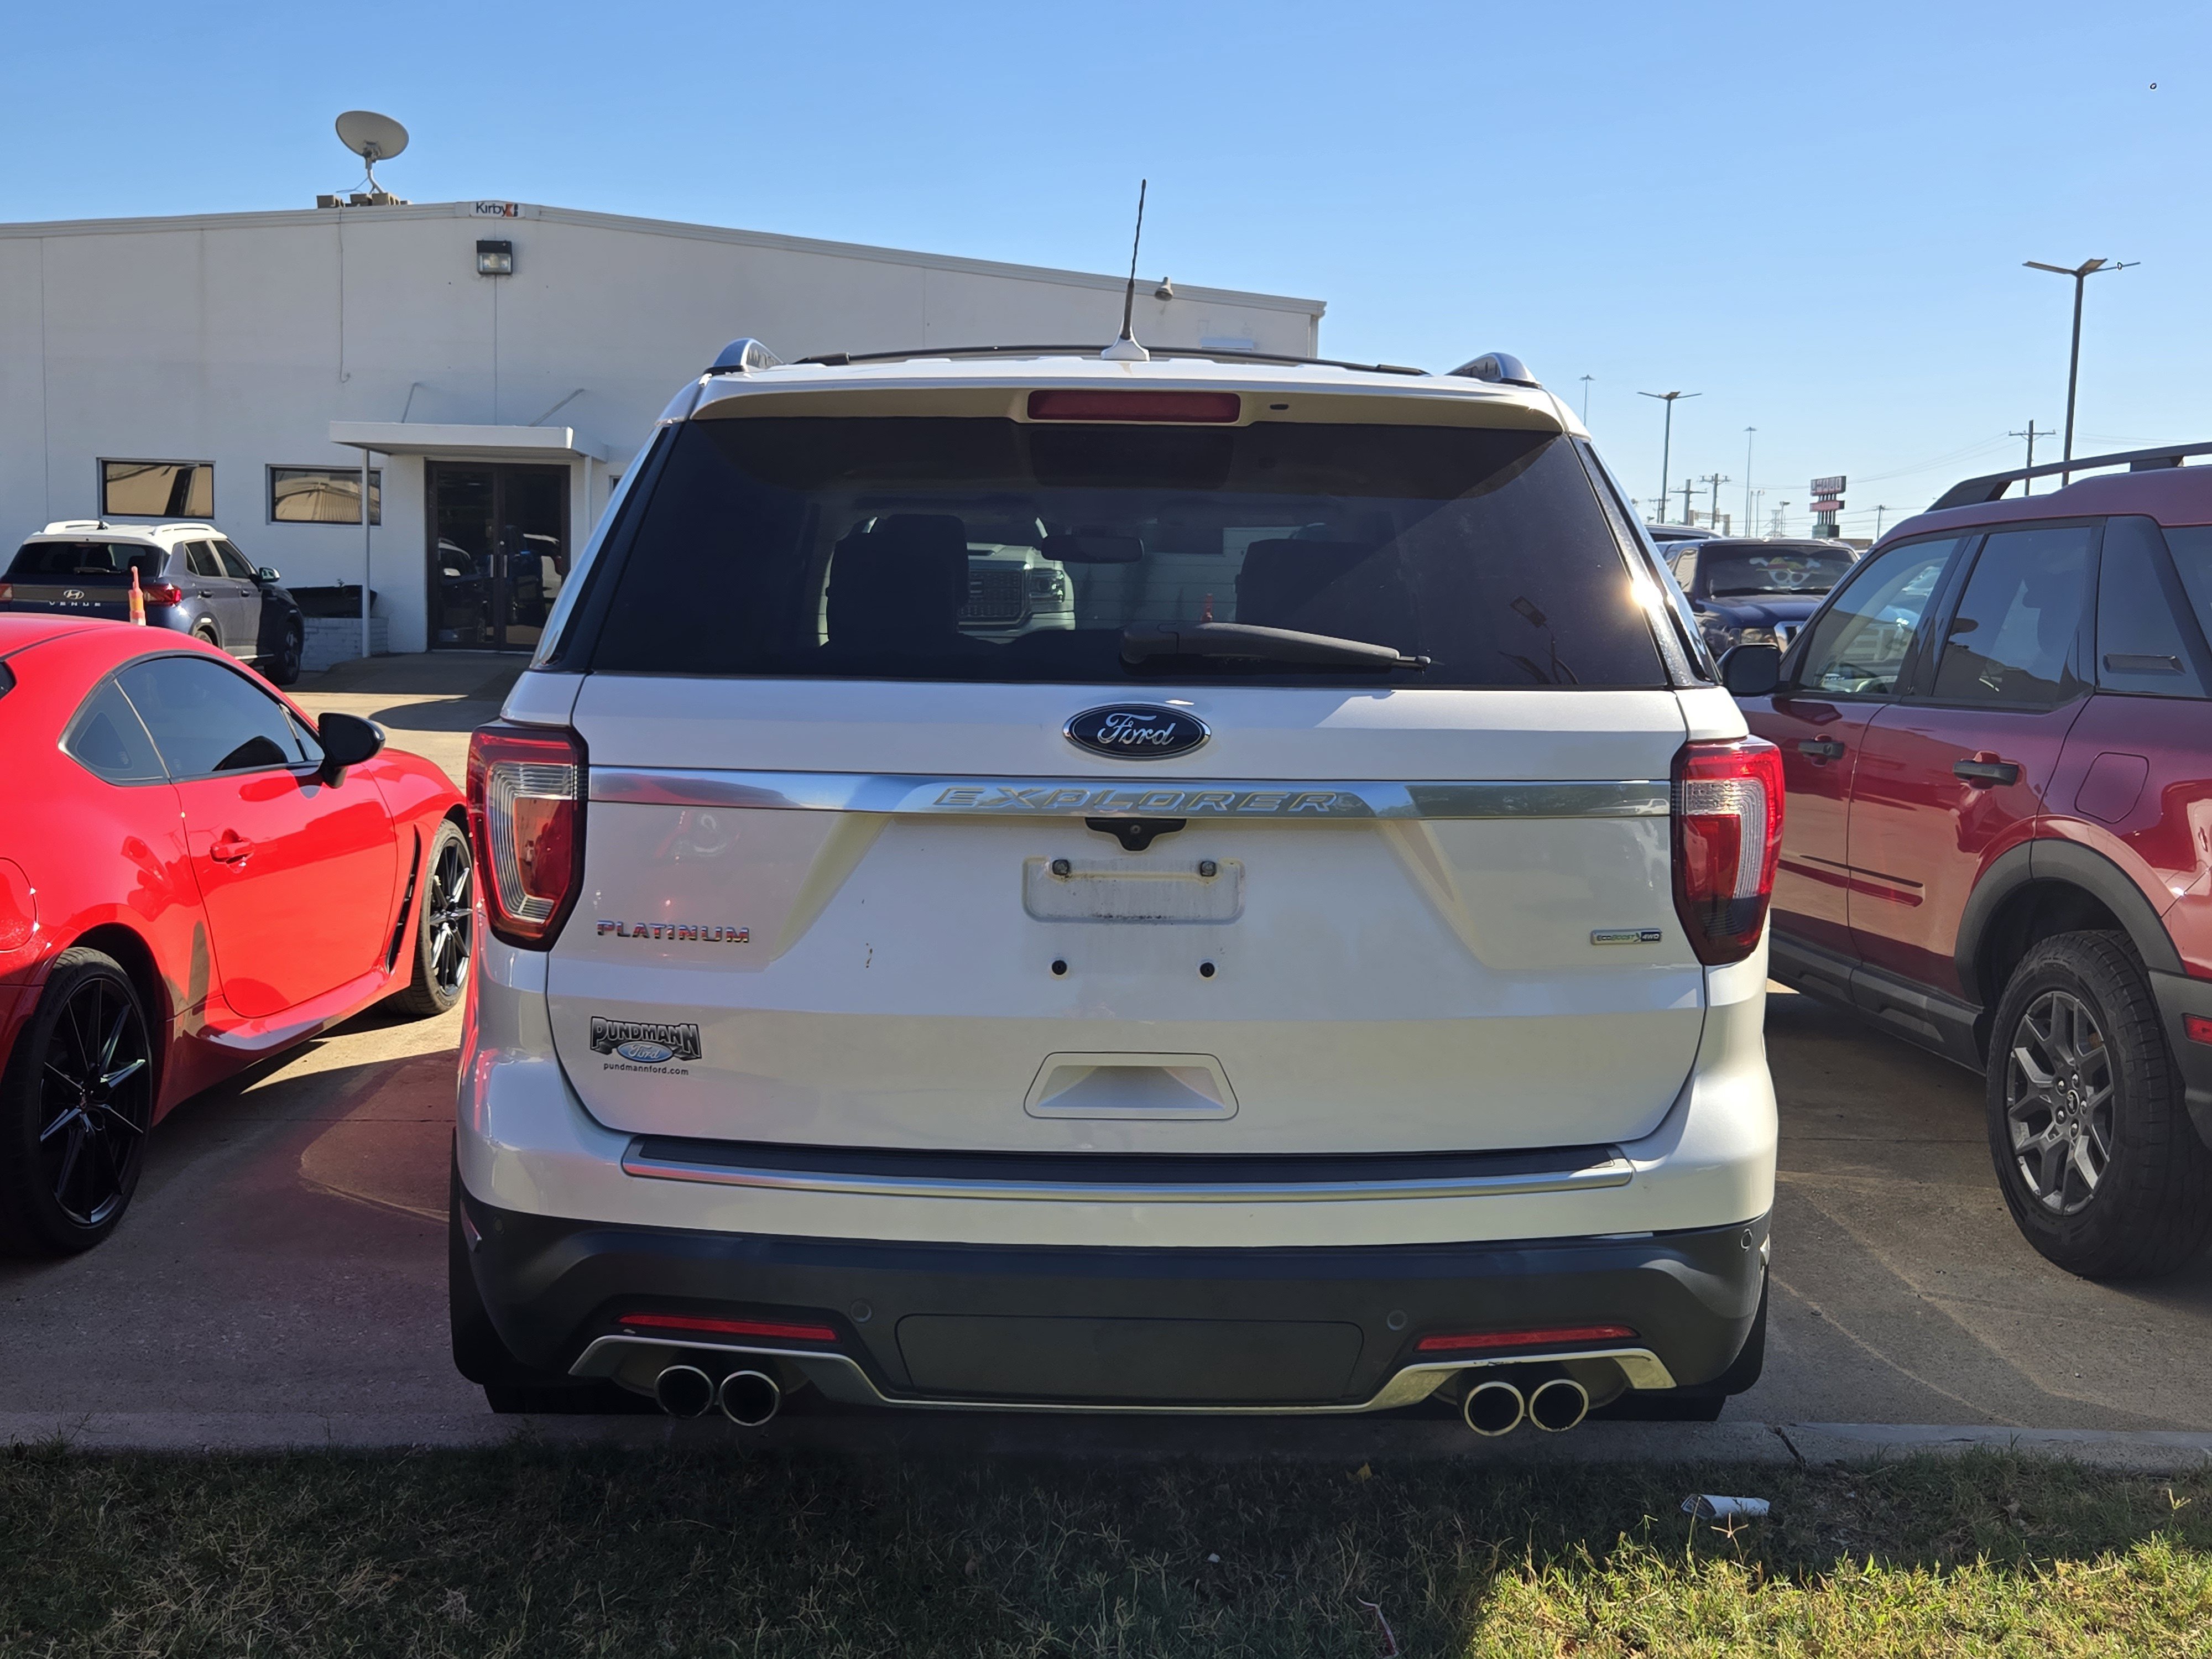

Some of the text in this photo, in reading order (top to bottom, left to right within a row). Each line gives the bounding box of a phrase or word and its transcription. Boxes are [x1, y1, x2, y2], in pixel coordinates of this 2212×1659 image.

[476, 202, 507, 217] Kirby
[1097, 713, 1176, 745] Ford
[932, 785, 1339, 813] EXPLORER
[597, 920, 750, 943] PLATINUM
[590, 1016, 702, 1060] PUNDMANN
[628, 1043, 660, 1059] Ford
[603, 1063, 689, 1076] pundmannford.com
